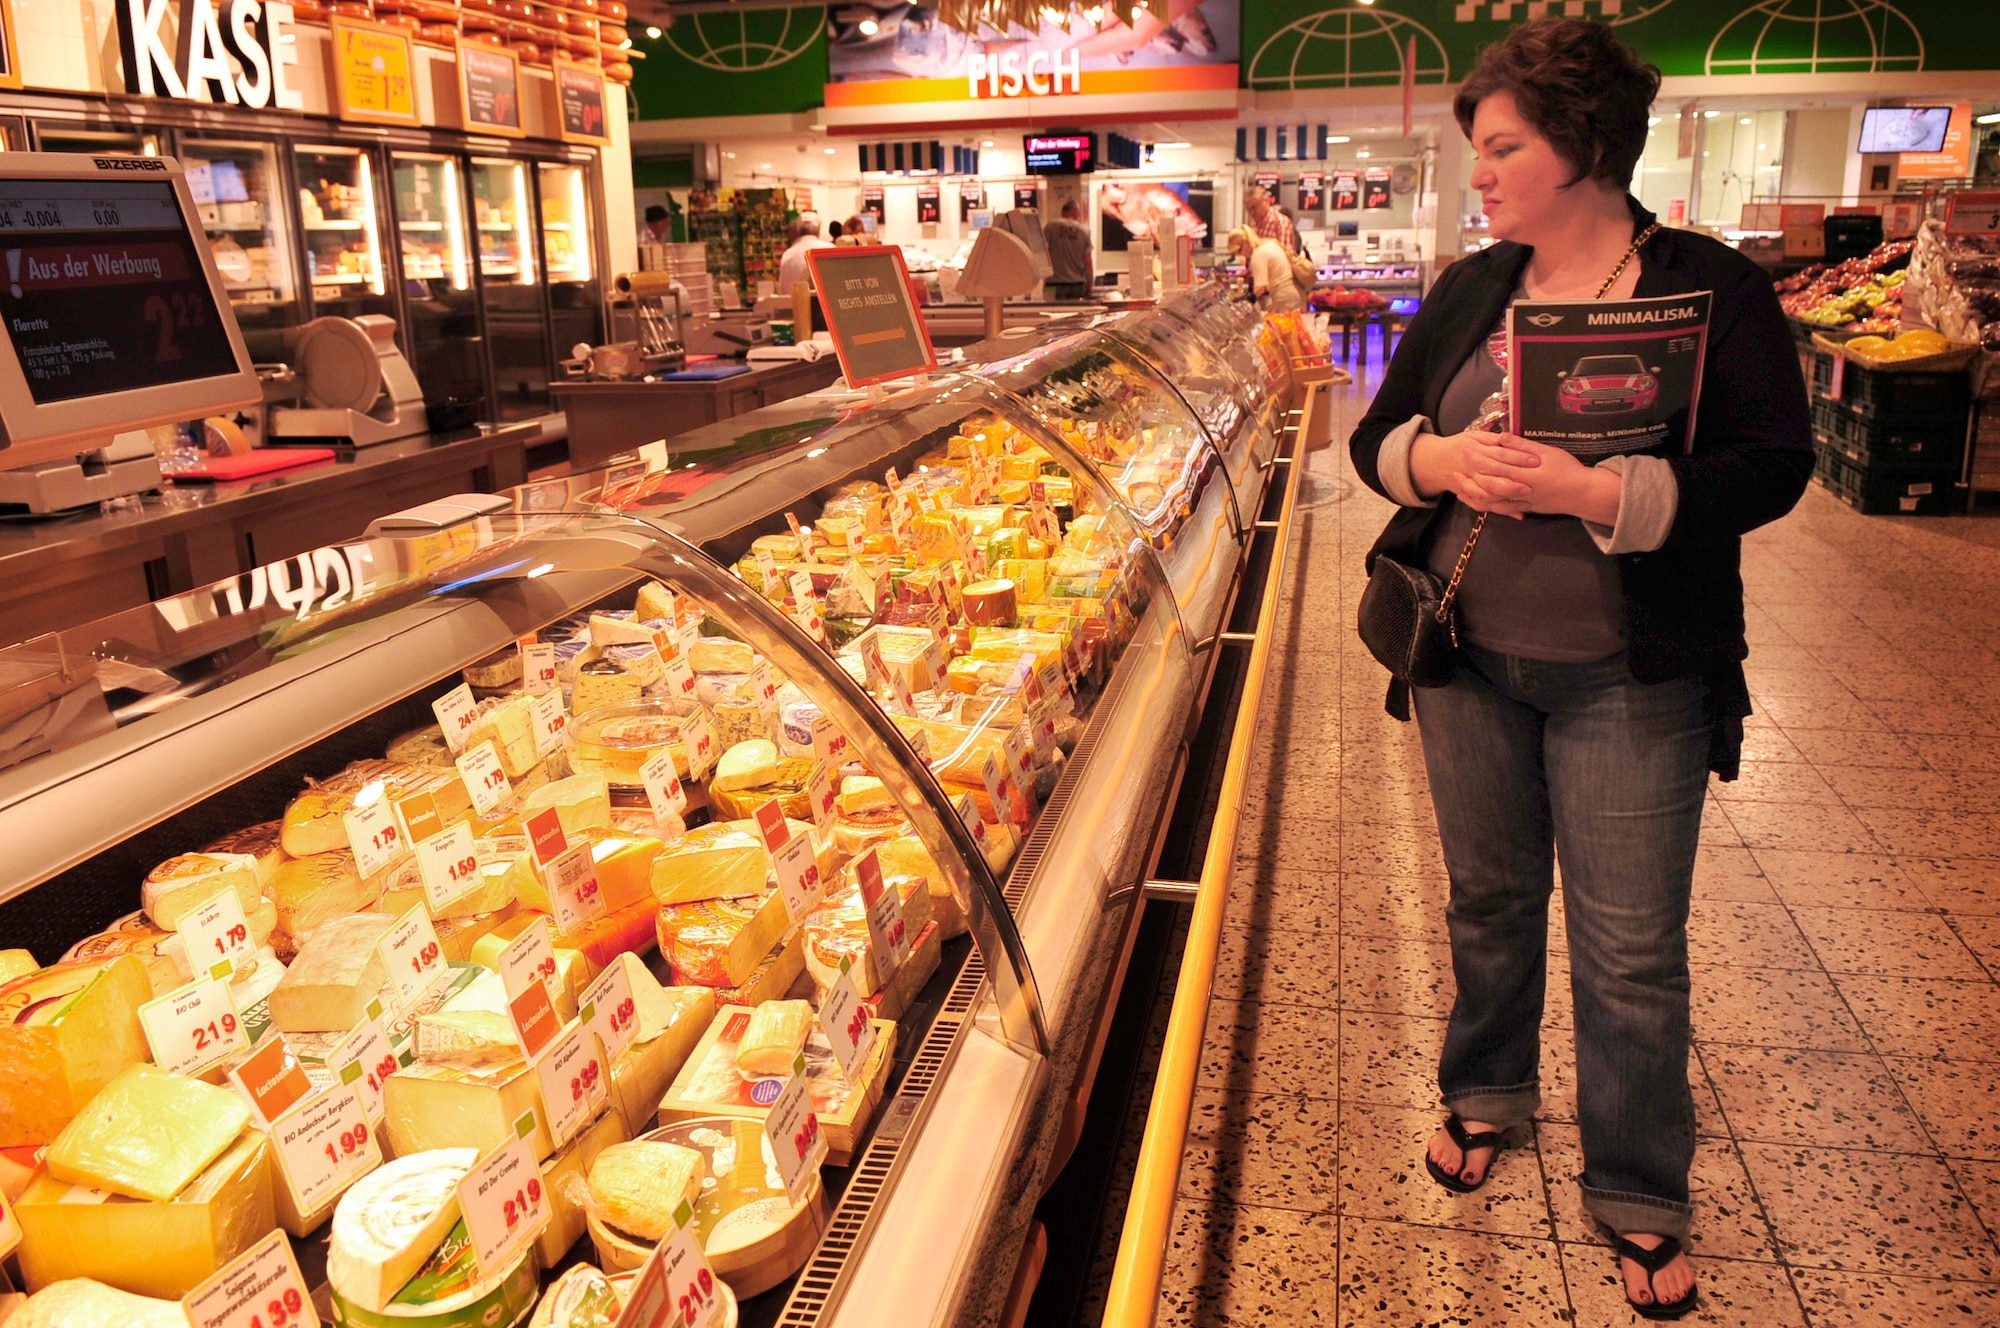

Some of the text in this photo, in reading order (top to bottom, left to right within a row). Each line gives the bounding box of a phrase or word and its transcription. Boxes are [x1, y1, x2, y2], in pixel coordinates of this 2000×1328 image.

[968, 48, 1080, 98] FISCH
[93, 158, 167, 171] BIZERBA
[22, 210, 61, 228] -0,004
[94, 209, 120, 226] 0,00
[28, 256, 60, 281] Aus
[64, 253, 90, 278] der
[92, 251, 163, 279] Werbung
[844, 277, 879, 291] BITTE VON
[838, 294, 897, 310] RECHTS ANSTELLEN
[1588, 306, 1699, 326] MINIMALISM.
[13, 318, 49, 332] Florette
[176, 1003, 187, 1015] BIO
[521, 1001, 550, 1033] Lactosefrei
[283, 1095, 355, 1146] BIO Andechser Bergkäse
